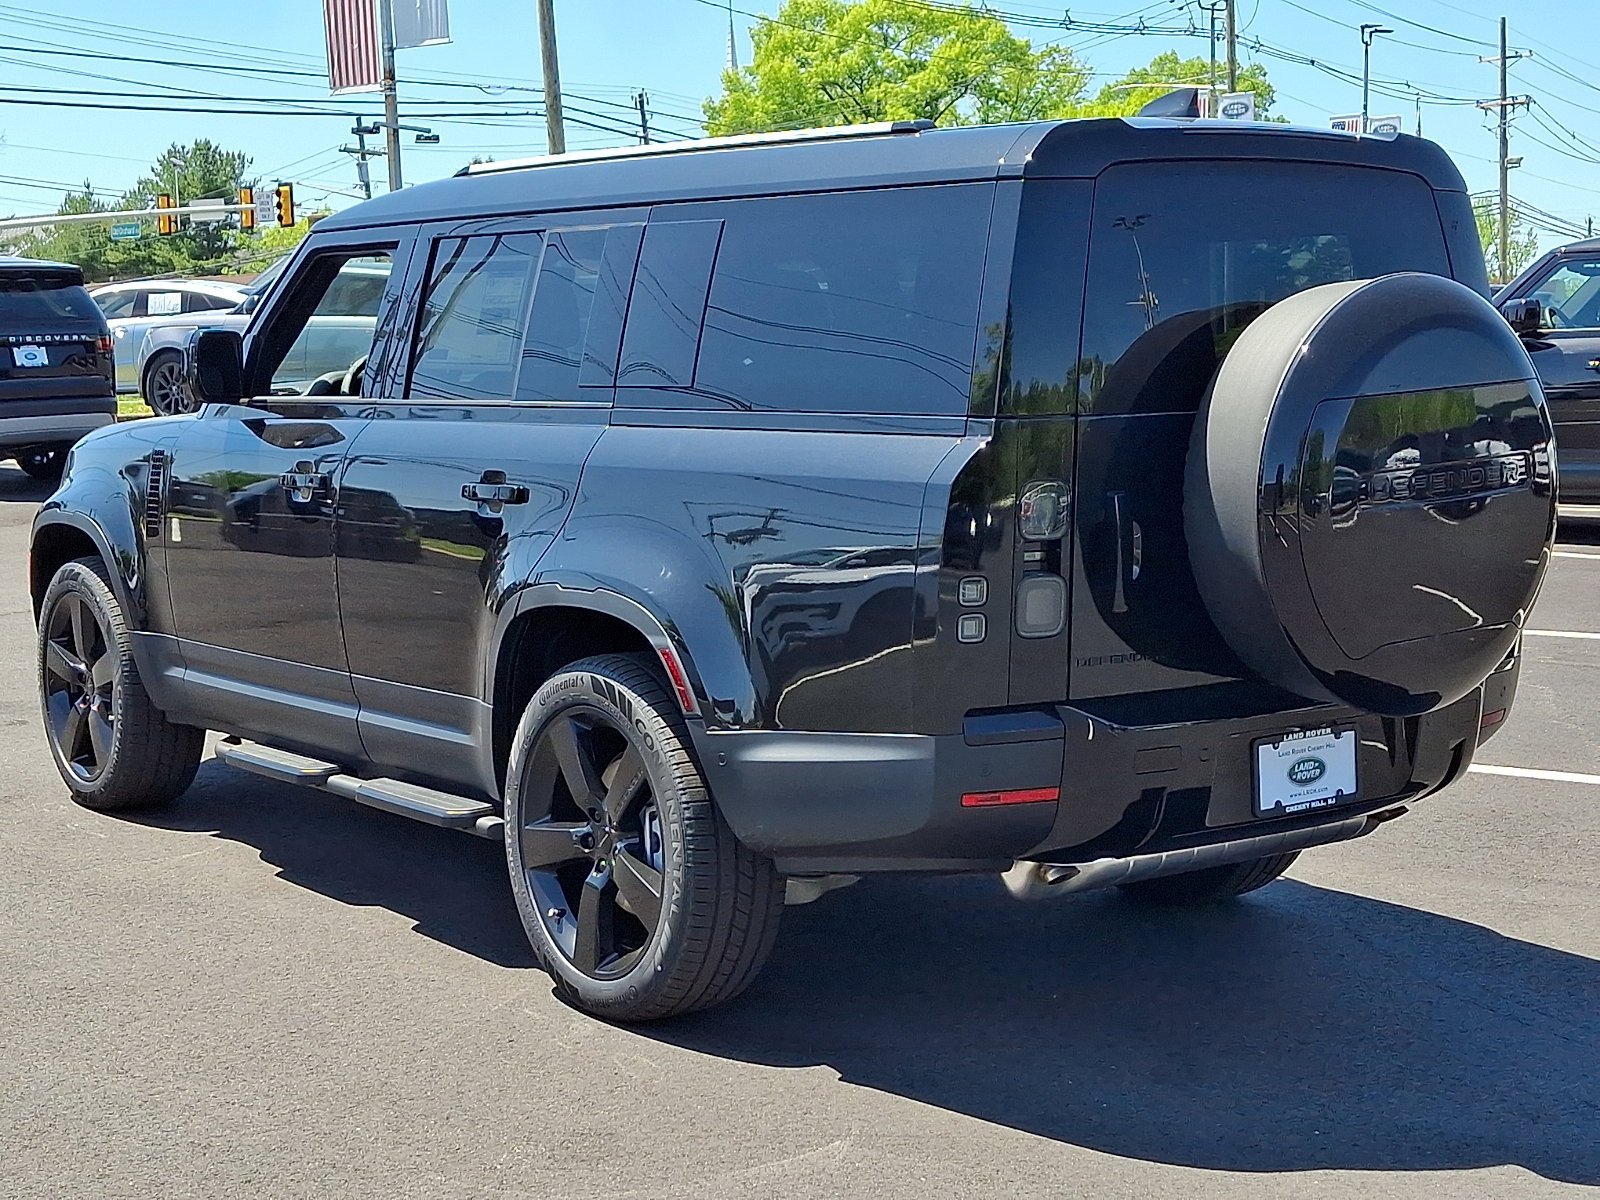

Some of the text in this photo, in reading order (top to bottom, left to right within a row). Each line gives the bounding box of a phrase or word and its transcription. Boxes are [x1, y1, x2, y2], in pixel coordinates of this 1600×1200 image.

[9, 334, 87, 342] DISCOVERY
[1371, 460, 1518, 499] DEFENDER
[1076, 653, 1164, 668] DEFENDE
[539, 675, 579, 706] Continental
[1283, 727, 1331, 741] LAND ROVER
[1295, 761, 1314, 773] LAND
[1296, 770, 1321, 781] ROVER
[1327, 797, 1336, 805] NJ
[635, 718, 682, 918] CONTINENTAL
